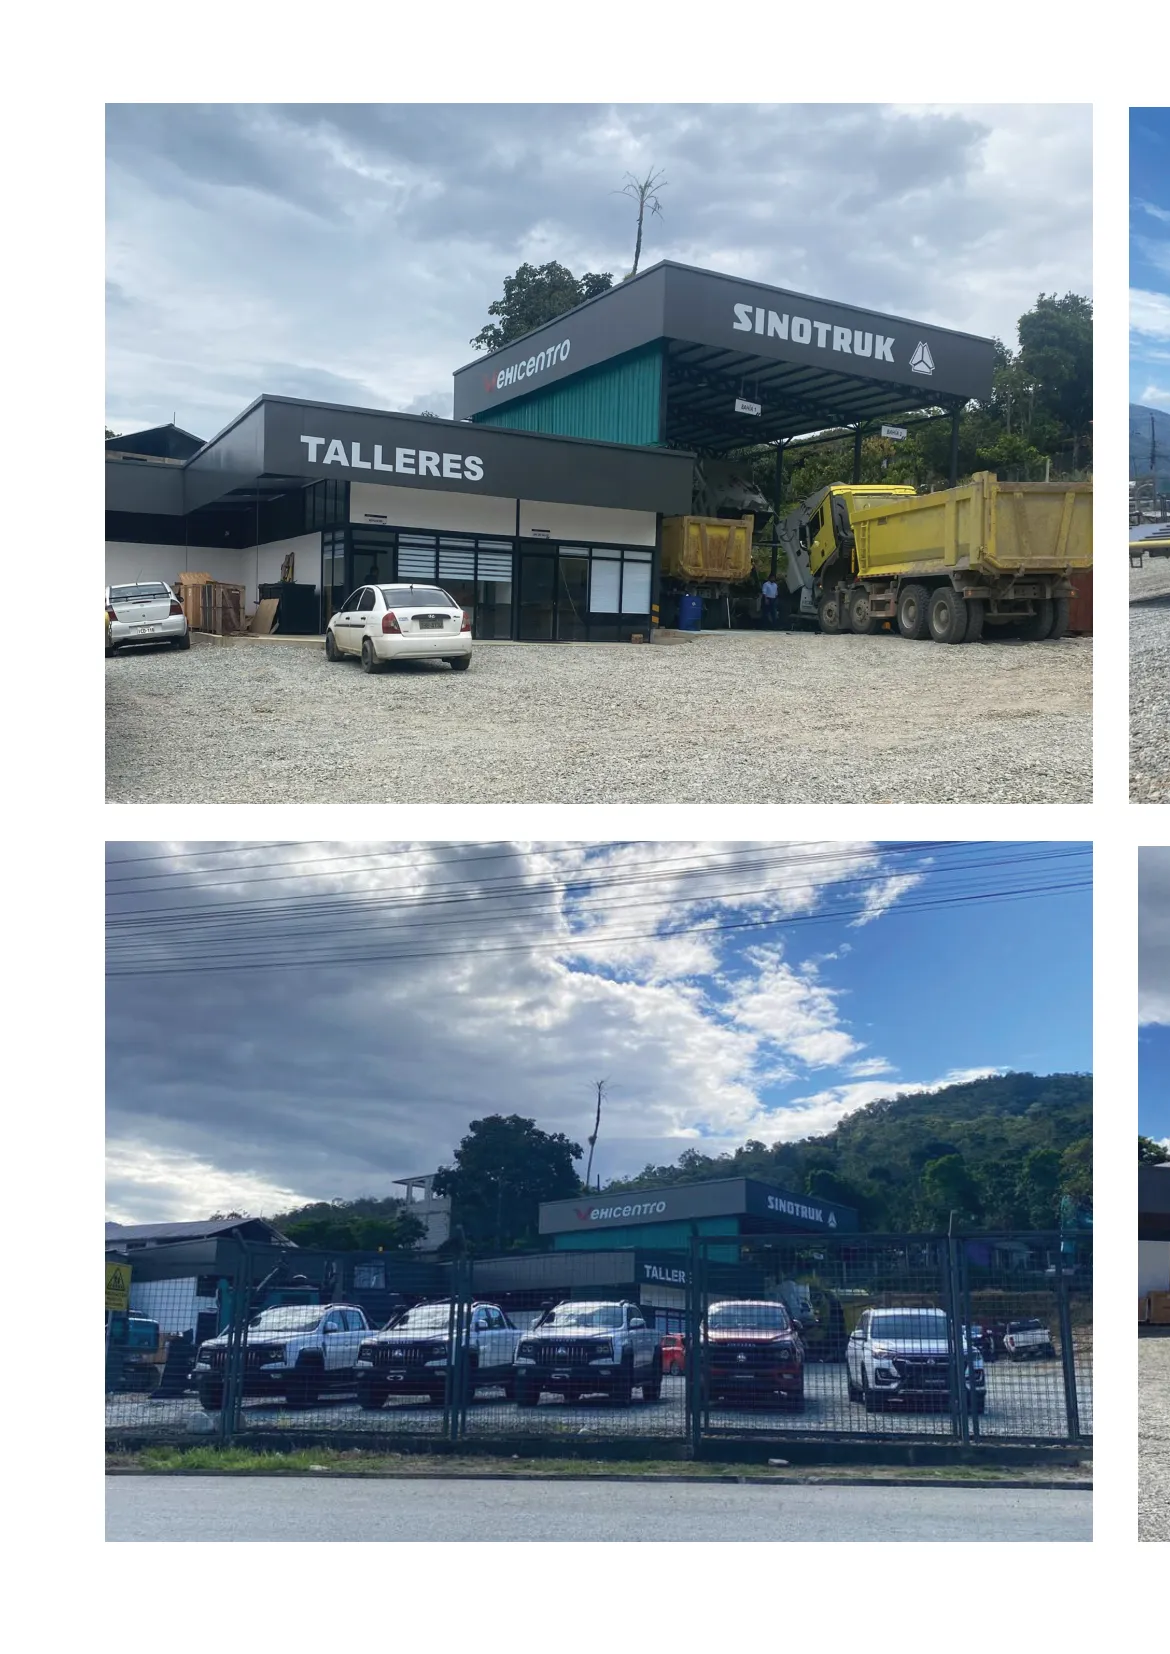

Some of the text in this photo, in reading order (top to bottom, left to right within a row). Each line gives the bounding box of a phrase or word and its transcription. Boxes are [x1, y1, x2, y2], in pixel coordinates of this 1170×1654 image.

[733, 303, 895, 363] SINOTRUK
[300, 435, 484, 481] TALLERES
[766, 1195, 824, 1223] SINOTRUK
[643, 1264, 692, 1284] TALLER
